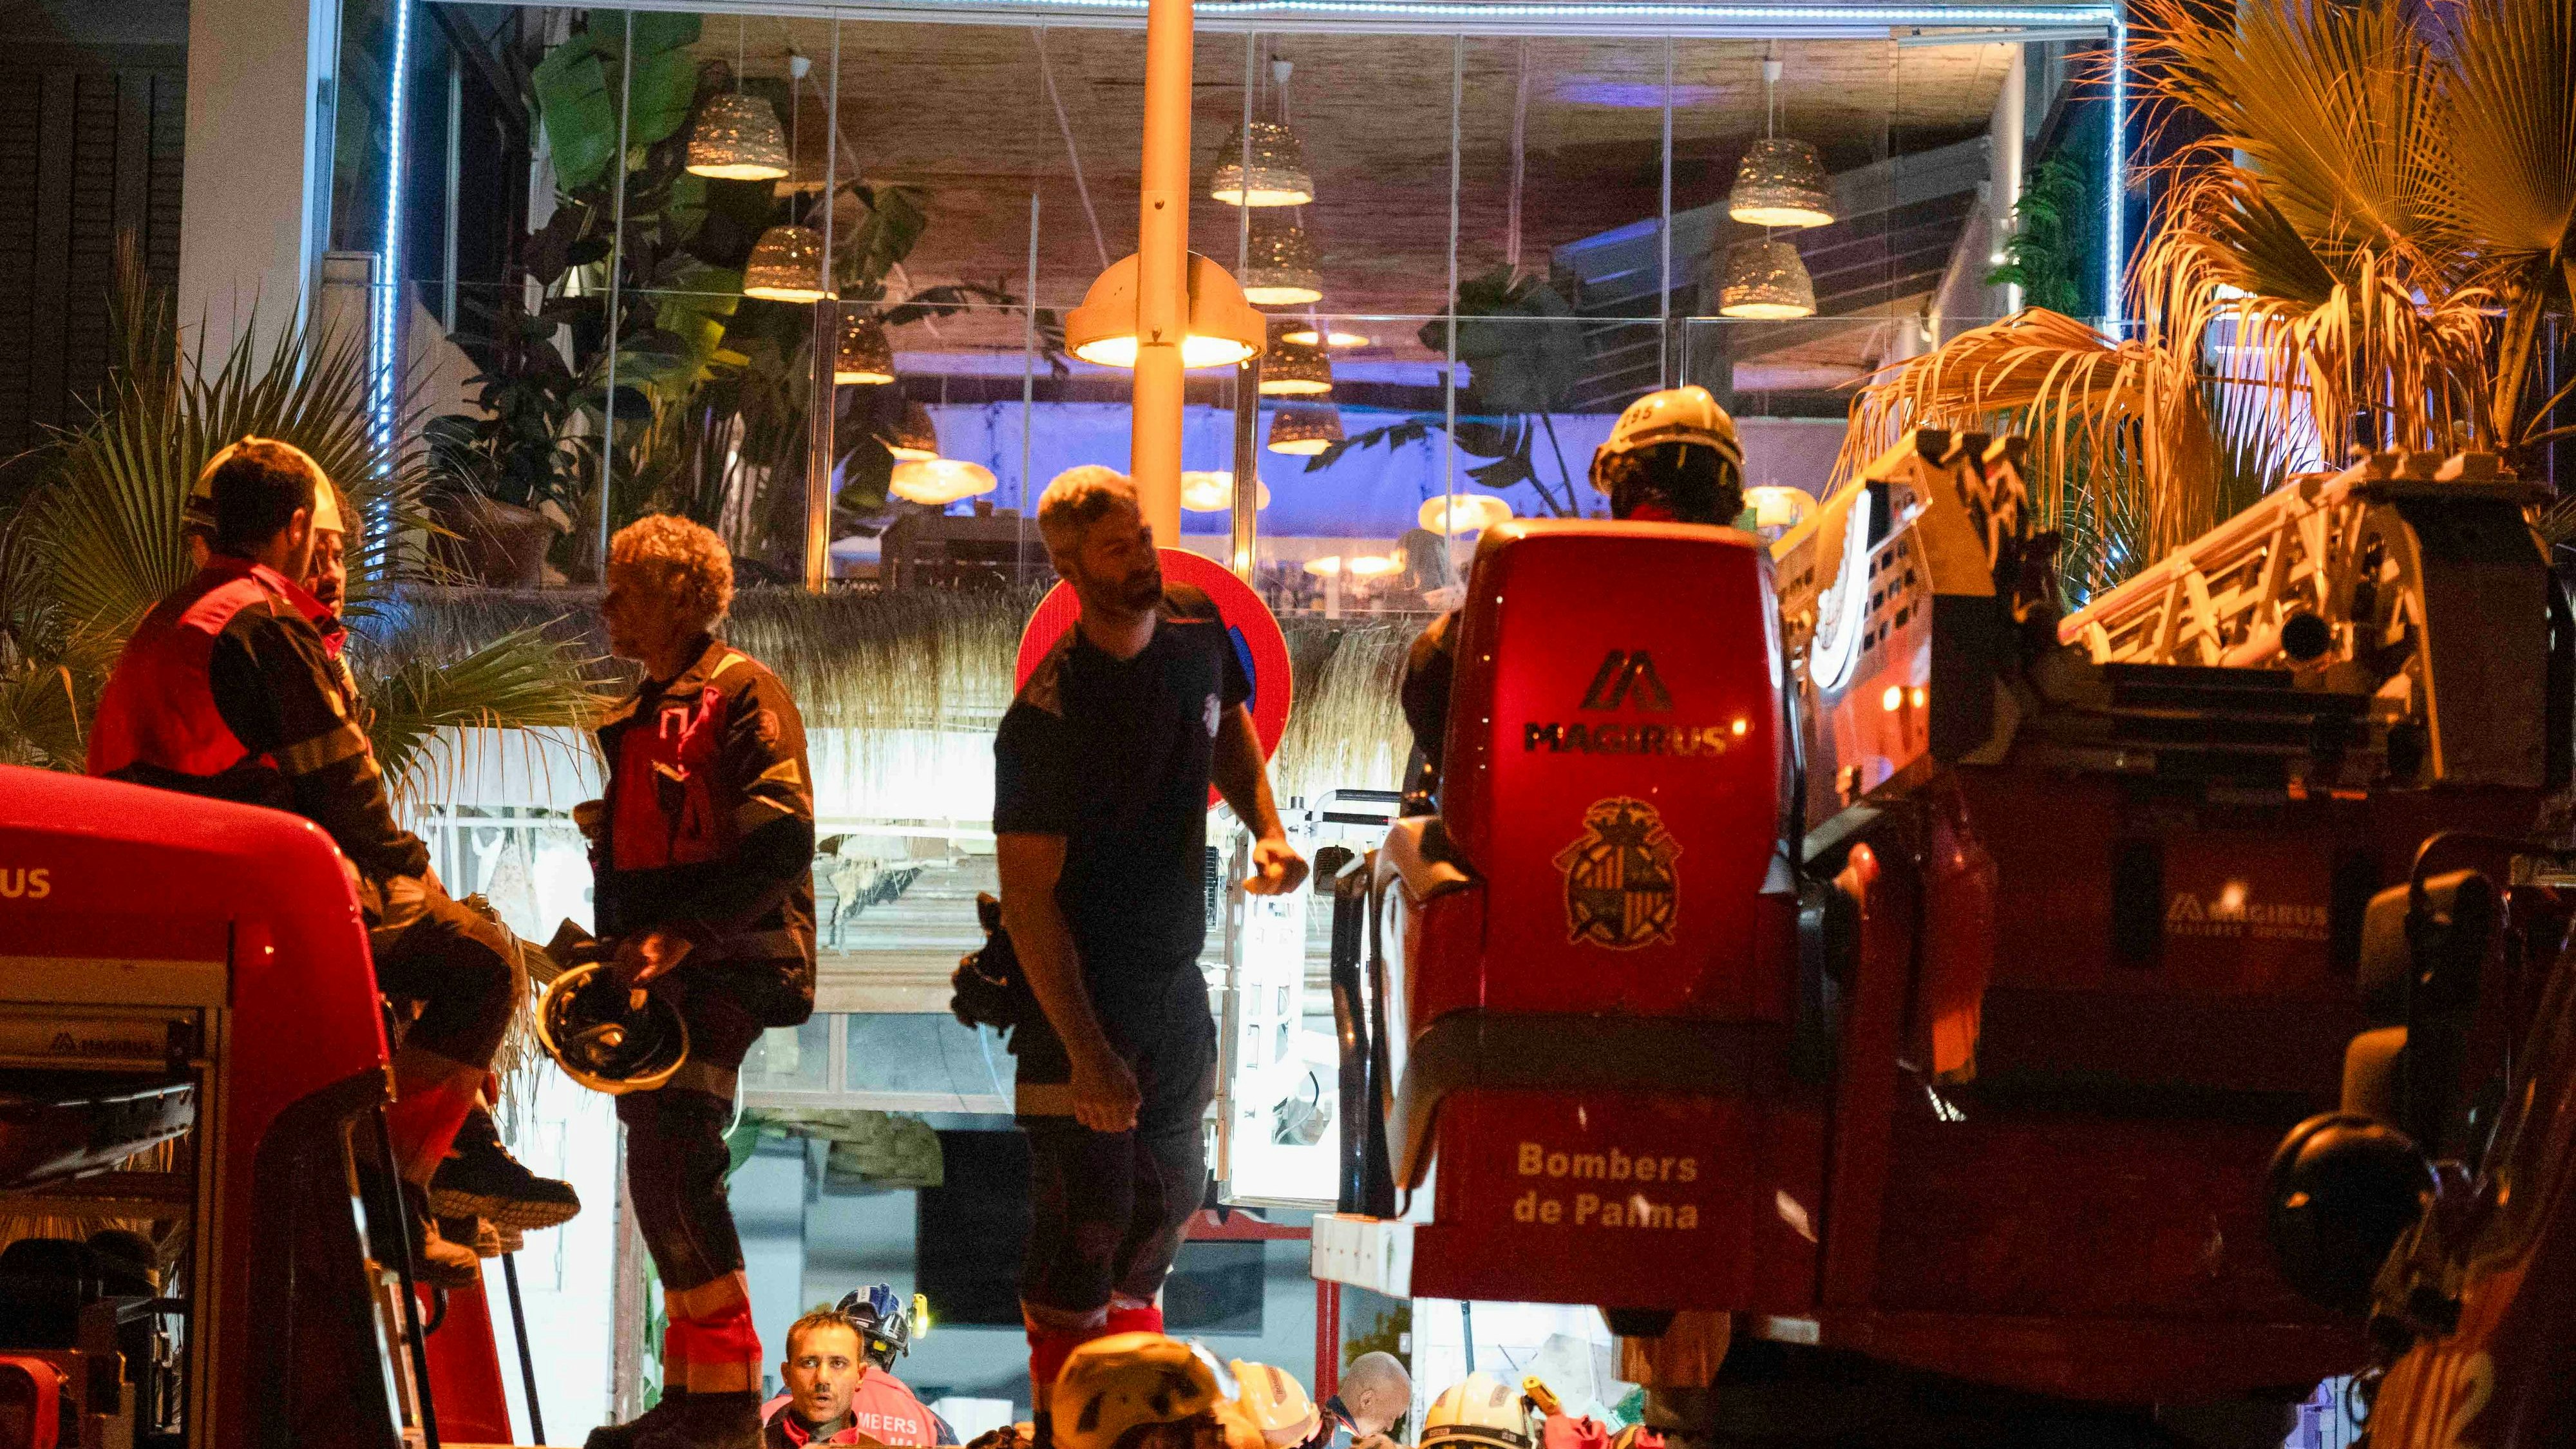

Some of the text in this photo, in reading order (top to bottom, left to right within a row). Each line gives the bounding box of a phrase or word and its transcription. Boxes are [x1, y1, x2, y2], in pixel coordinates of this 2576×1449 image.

[1524, 721, 1727, 756] MAGIRUS
[1518, 1142, 1698, 1182] Bombers
[1514, 1191, 1698, 1229] de Palma
